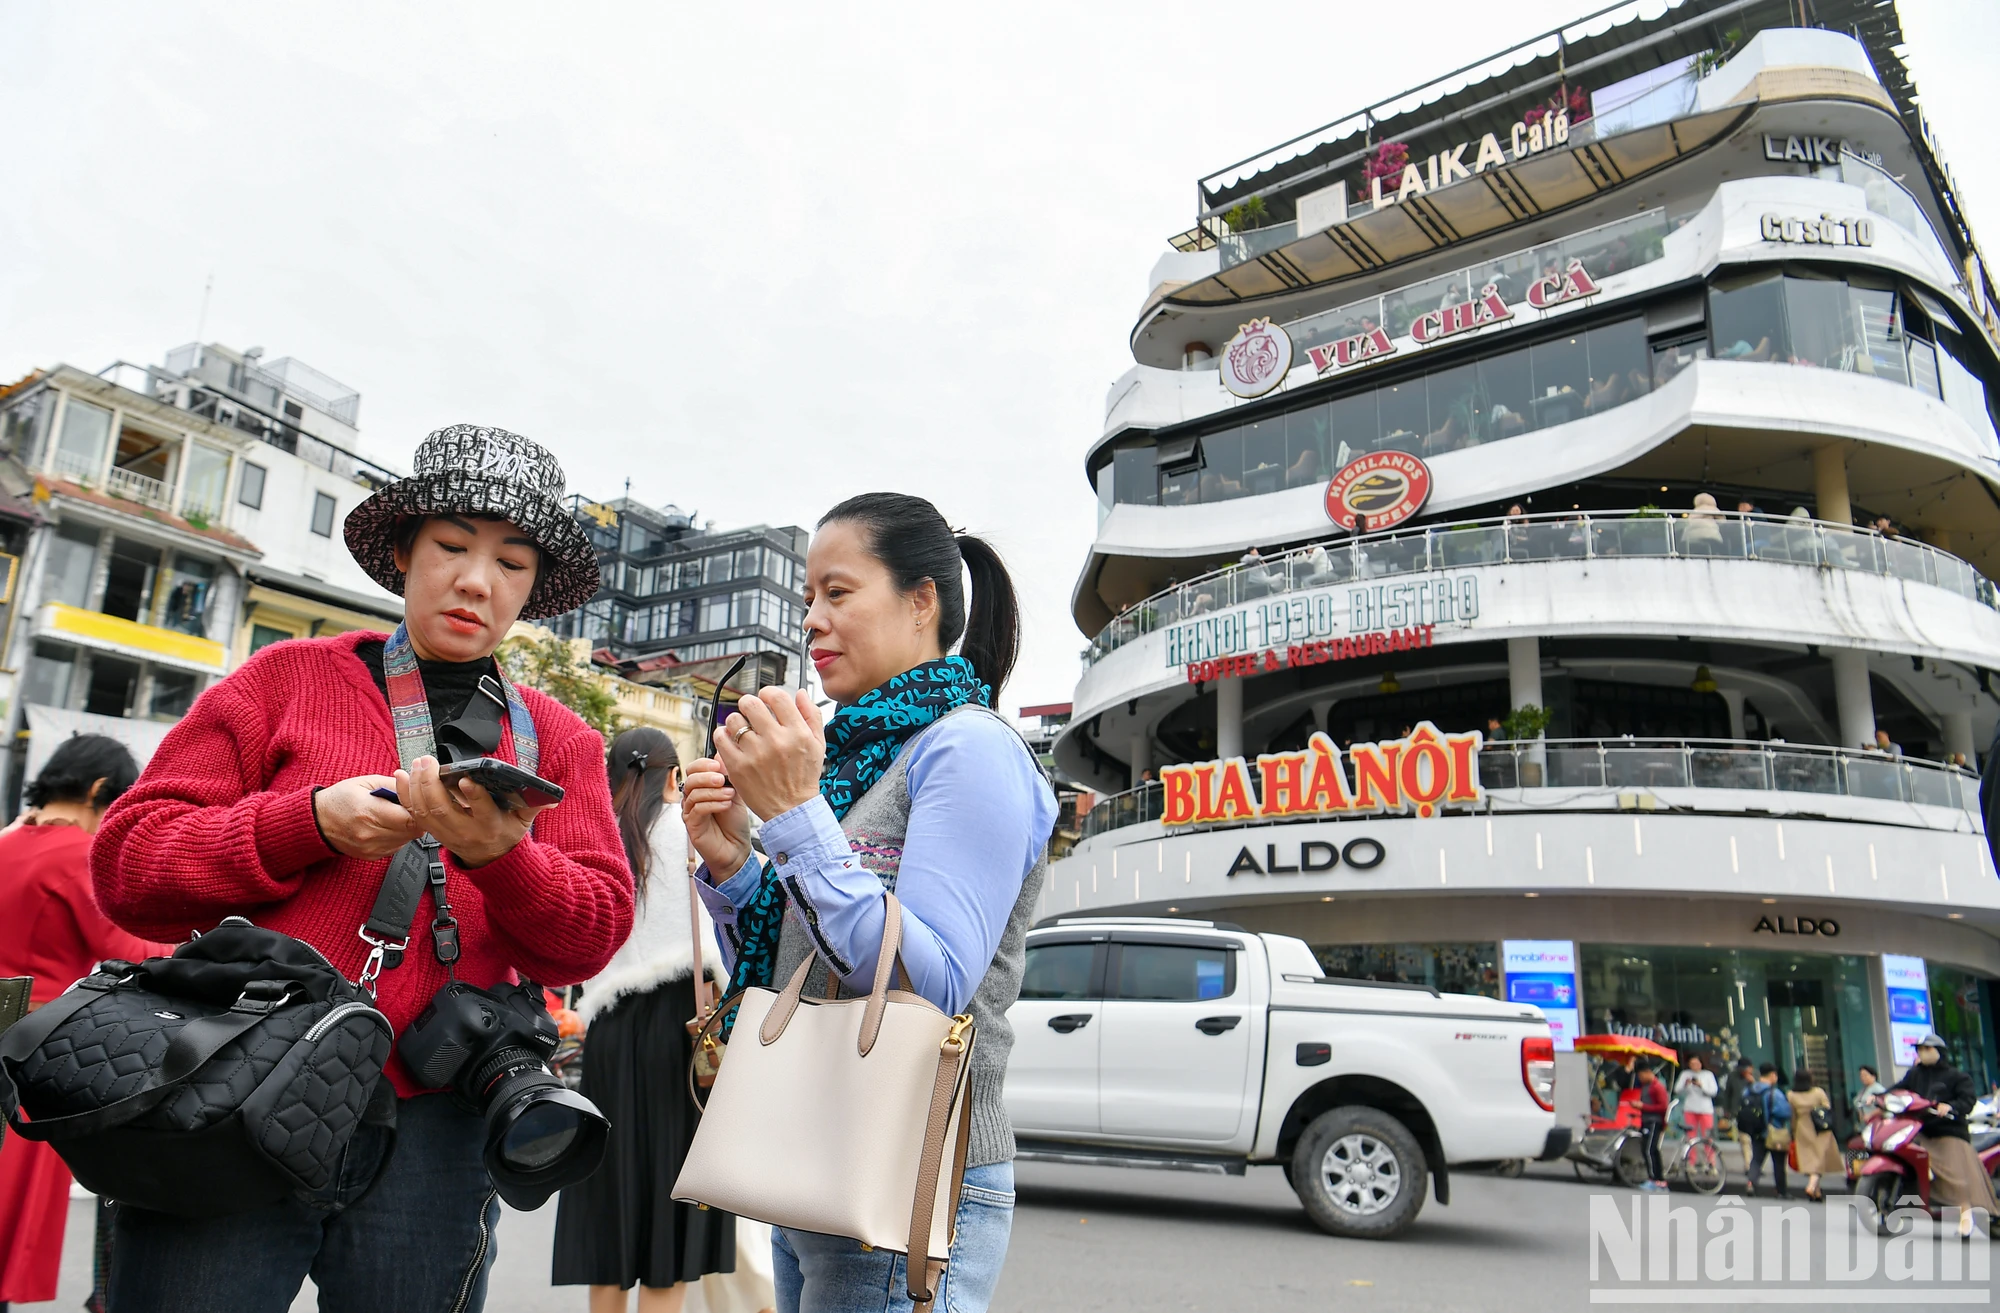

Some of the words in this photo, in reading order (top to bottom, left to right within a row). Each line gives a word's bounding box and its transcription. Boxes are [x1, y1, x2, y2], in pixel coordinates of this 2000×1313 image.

[1371, 132, 1507, 210] LAIKA
[1511, 107, 1569, 160] Café
[1841, 217, 1874, 246] 10
[1305, 326, 1397, 374] VUA
[1409, 284, 1514, 343] CHẢ
[1526, 258, 1601, 309] CÁ
[1330, 455, 1423, 498] HIGHLANDS
[1342, 500, 1414, 529] CFFEE
[1165, 610, 1248, 668] HANOI
[1257, 593, 1333, 646] 1930
[1348, 575, 1479, 632] BISTRO
[1186, 652, 1259, 684] COFFEE
[1264, 649, 1280, 671] &
[1287, 624, 1436, 668] RESTAURANT
[1161, 762, 1254, 825] BIA
[1259, 737, 1350, 817] HÀ
[1353, 725, 1479, 819] NỘI
[1226, 838, 1386, 877] ALDO
[1754, 915, 1840, 937] ALDO
[1510, 953, 1569, 963] mobifone
[534, 1033, 557, 1047] Canon
